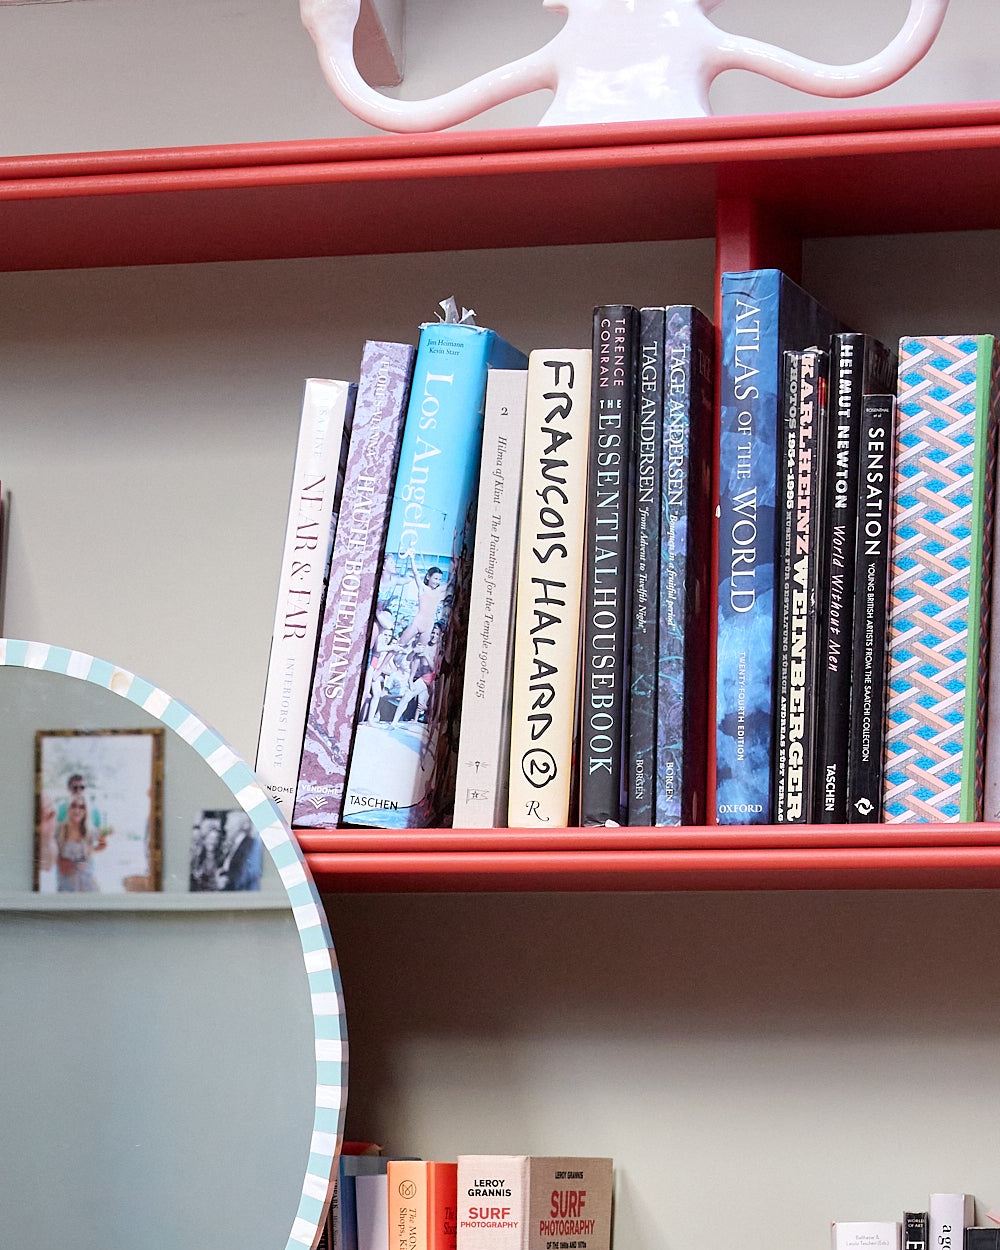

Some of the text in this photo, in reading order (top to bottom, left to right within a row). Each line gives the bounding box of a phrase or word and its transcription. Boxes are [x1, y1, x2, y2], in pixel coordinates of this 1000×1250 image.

[600, 318, 611, 388] CONRAN
[613, 318, 626, 387] TERENCE
[600, 400, 623, 409] THE
[639, 341, 658, 503] TAGE ANDERSEN
[667, 344, 686, 506] TAGE ANDERSEN
[786, 355, 798, 510] PHOTOS 1954-1995
[397, 371, 454, 560] Los Angeles
[828, 344, 854, 672] HELMUT NEWTON World Without Men
[864, 427, 885, 555] SENSATION
[479, 436, 507, 650] Hilma af Klint The Paintings for the Temple
[527, 360, 575, 741] FRANÇOIS HALARD
[731, 299, 761, 761] ATLAS OF THE WORLD TWENTY-FOURTH EDITION
[283, 474, 327, 640] NEAR & FAR
[325, 475, 376, 699] HAUTE BOHEMIANS
[301, 784, 341, 795] VENDOME
[634, 759, 644, 799] BORGEN
[665, 761, 675, 802] BORGEN
[825, 764, 837, 812] TASCHEN
[350, 796, 398, 811] TASCHEN
[719, 804, 763, 813] OXFORD
[467, 1188, 512, 1197] GRANNIS
[474, 1179, 505, 1188] LEROY
[550, 1190, 587, 1219] SURF
[398, 1207, 408, 1236] Shops,
[409, 1208, 417, 1223] The
[468, 1207, 511, 1219] SURF
[540, 1219, 595, 1236] PHOTOGRAPHY
[943, 1224, 952, 1233] a
